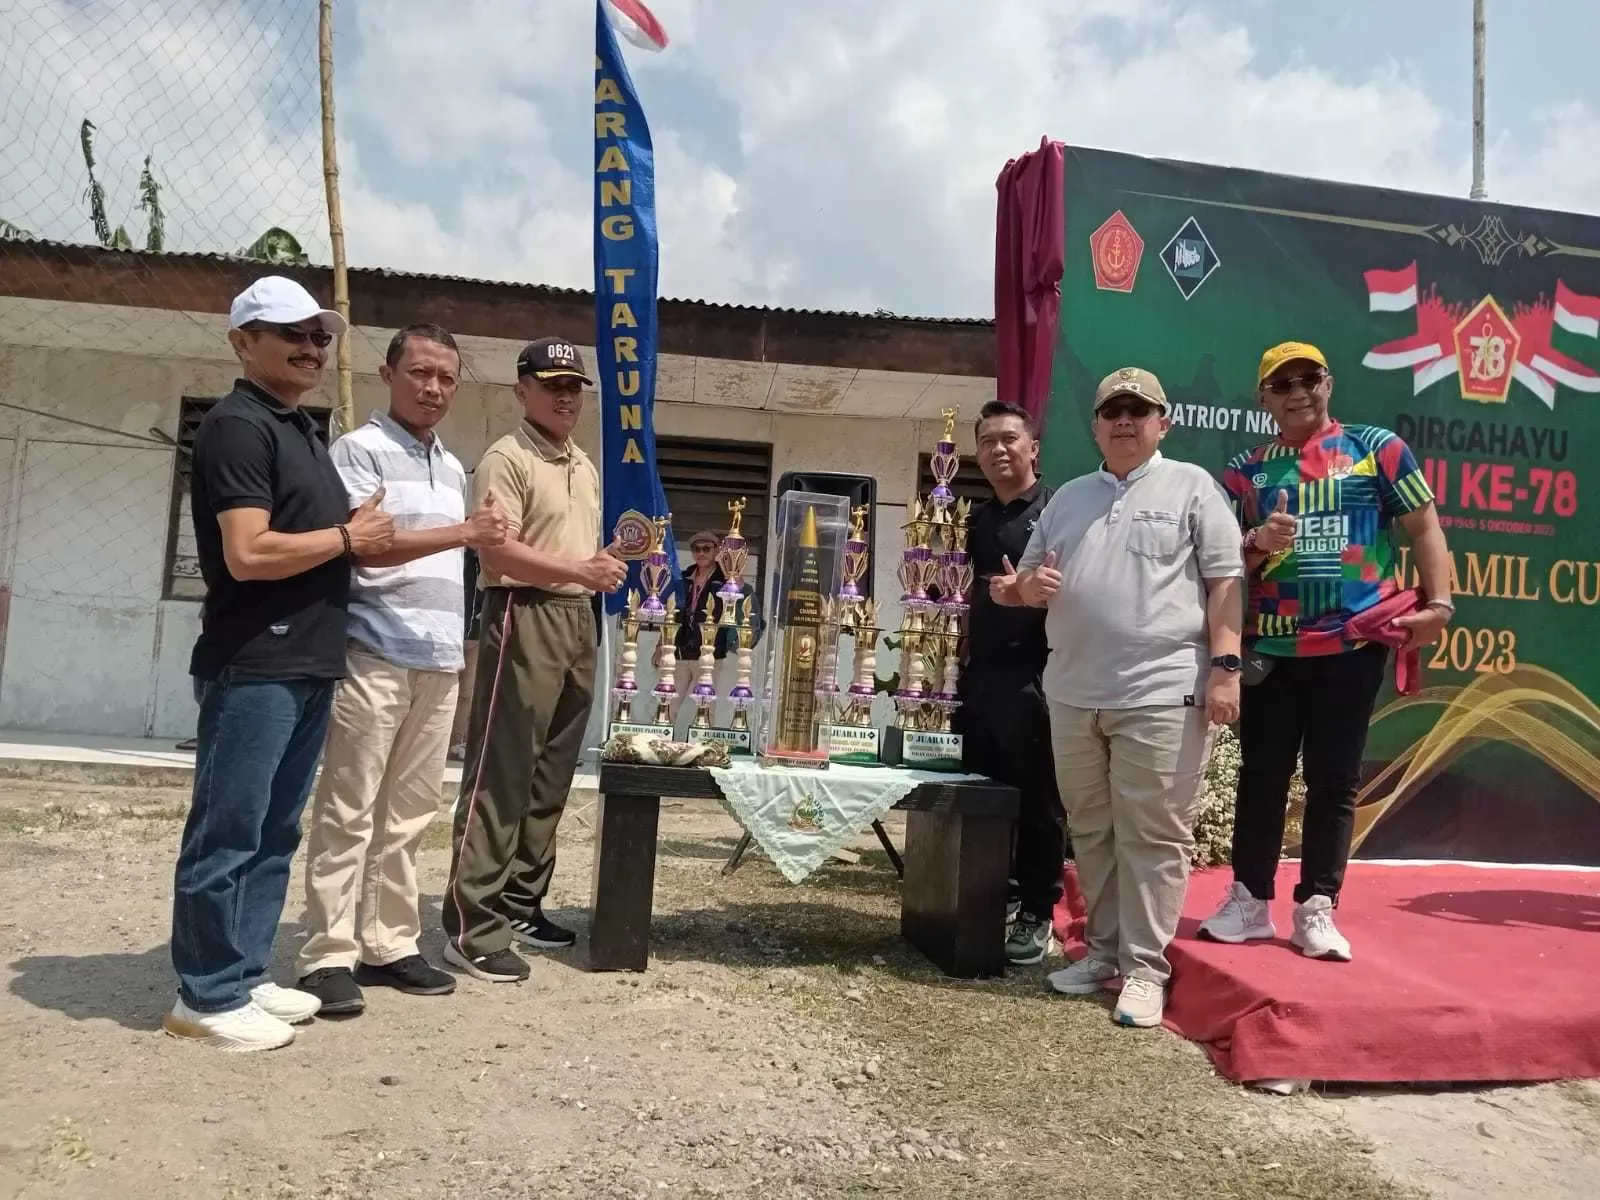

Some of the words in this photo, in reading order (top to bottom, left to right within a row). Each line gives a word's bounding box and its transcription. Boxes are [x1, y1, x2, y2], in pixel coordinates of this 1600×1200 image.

[547, 343, 574, 361] 0621
[603, 268, 645, 464] TARUNA
[1245, 410, 1281, 436] NK
[1396, 414, 1568, 462] DIRGAHAYU
[1459, 462, 1578, 517] KE-78
[1293, 537, 1349, 553] BOGOR
[1428, 627, 1517, 674] 2023
